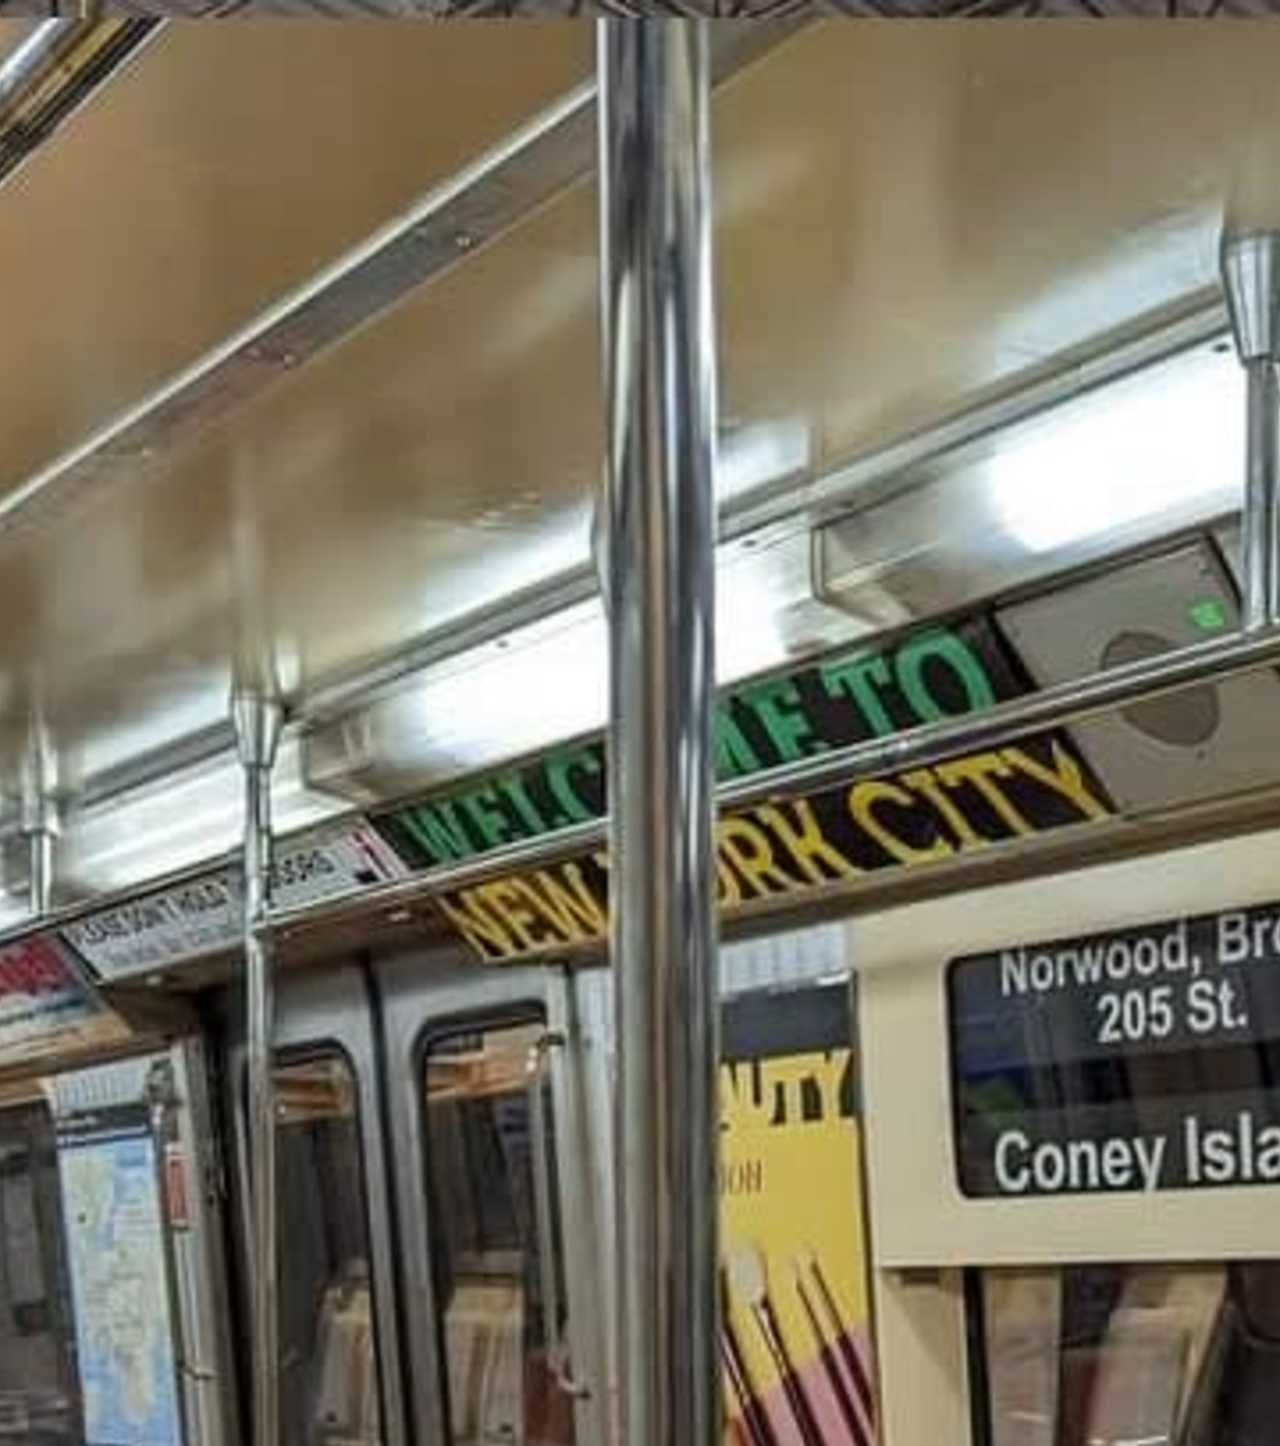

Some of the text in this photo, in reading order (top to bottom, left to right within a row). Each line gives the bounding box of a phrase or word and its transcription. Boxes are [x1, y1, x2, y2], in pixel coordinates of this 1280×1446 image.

[823, 627, 995, 738] TO
[436, 863, 610, 965] NEW
[849, 737, 1112, 866] CITY
[1001, 924, 1203, 996] Norwood,
[1097, 979, 1248, 1043] 205 St.
[994, 1128, 1165, 1191] Coney
